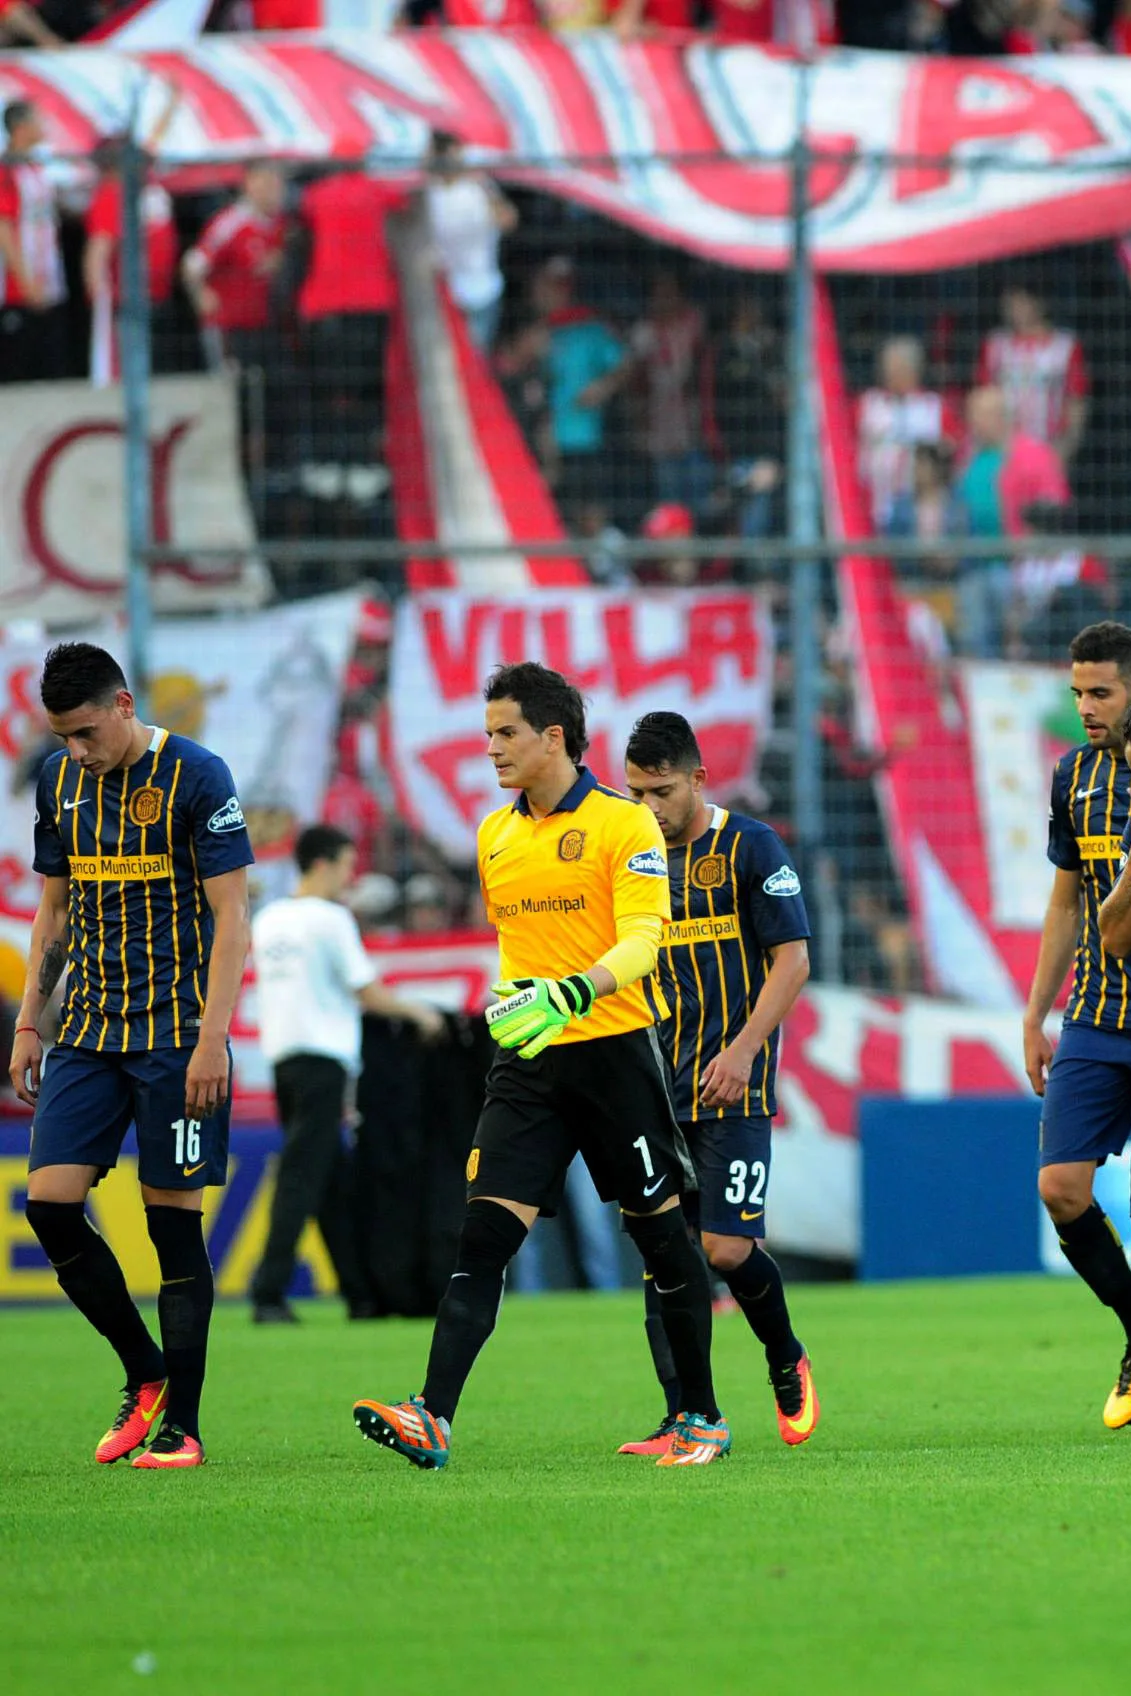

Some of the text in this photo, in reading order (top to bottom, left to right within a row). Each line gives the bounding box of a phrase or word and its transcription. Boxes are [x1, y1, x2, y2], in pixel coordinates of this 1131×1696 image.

[423, 600, 760, 703] VILLA
[70, 857, 166, 875] anco Municipal
[521, 894, 586, 915] Municipal
[668, 920, 735, 939] Municipal
[490, 992, 533, 1019] reusch
[171, 1118, 201, 1164] 16
[633, 1135, 655, 1177] 1
[725, 1160, 766, 1206] 32
